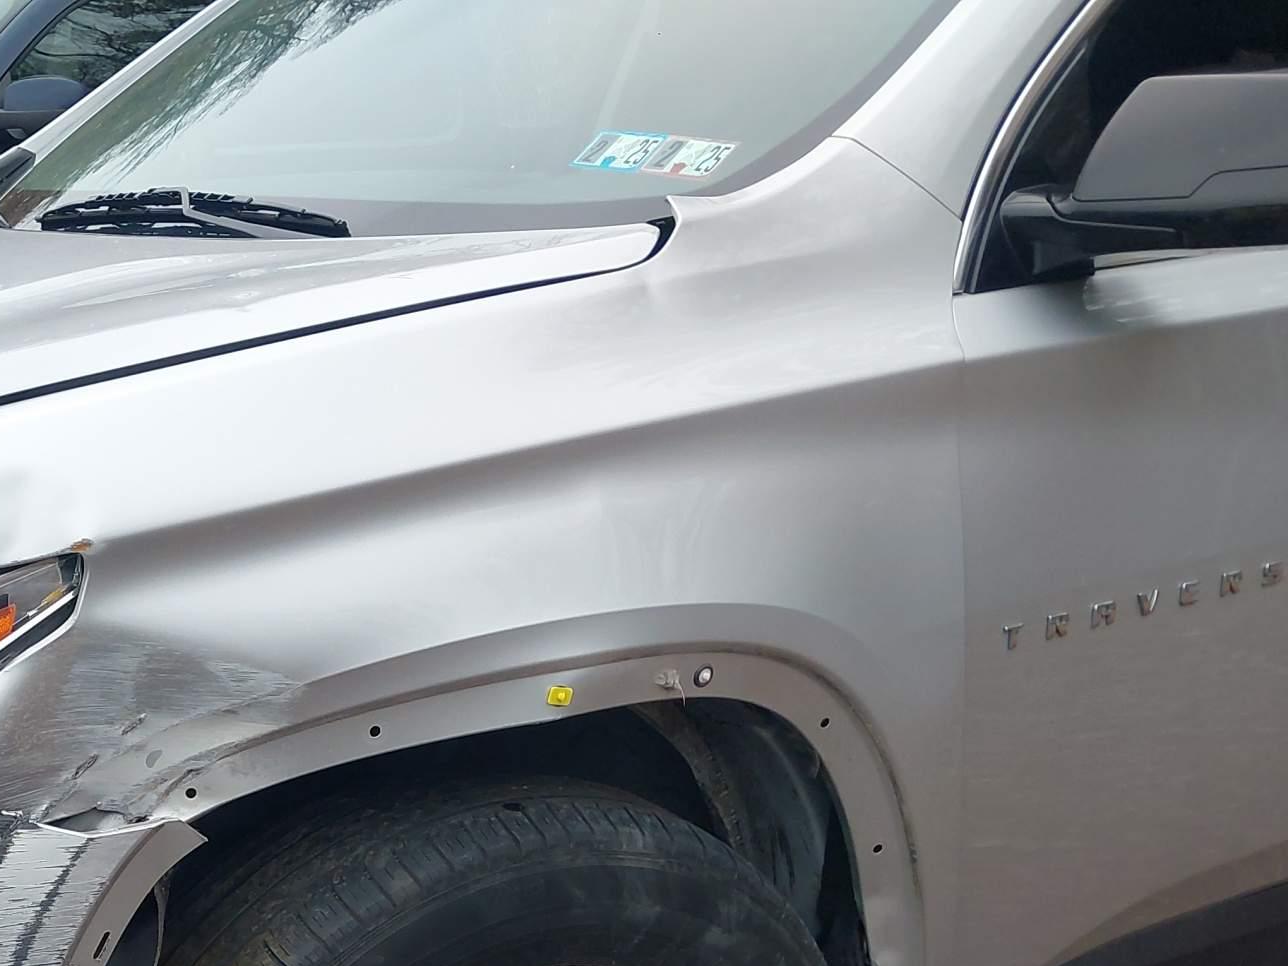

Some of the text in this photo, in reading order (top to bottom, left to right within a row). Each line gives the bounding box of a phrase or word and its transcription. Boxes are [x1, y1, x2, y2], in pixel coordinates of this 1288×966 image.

[583, 138, 659, 165] 2 25
[654, 141, 732, 173] 2 25
